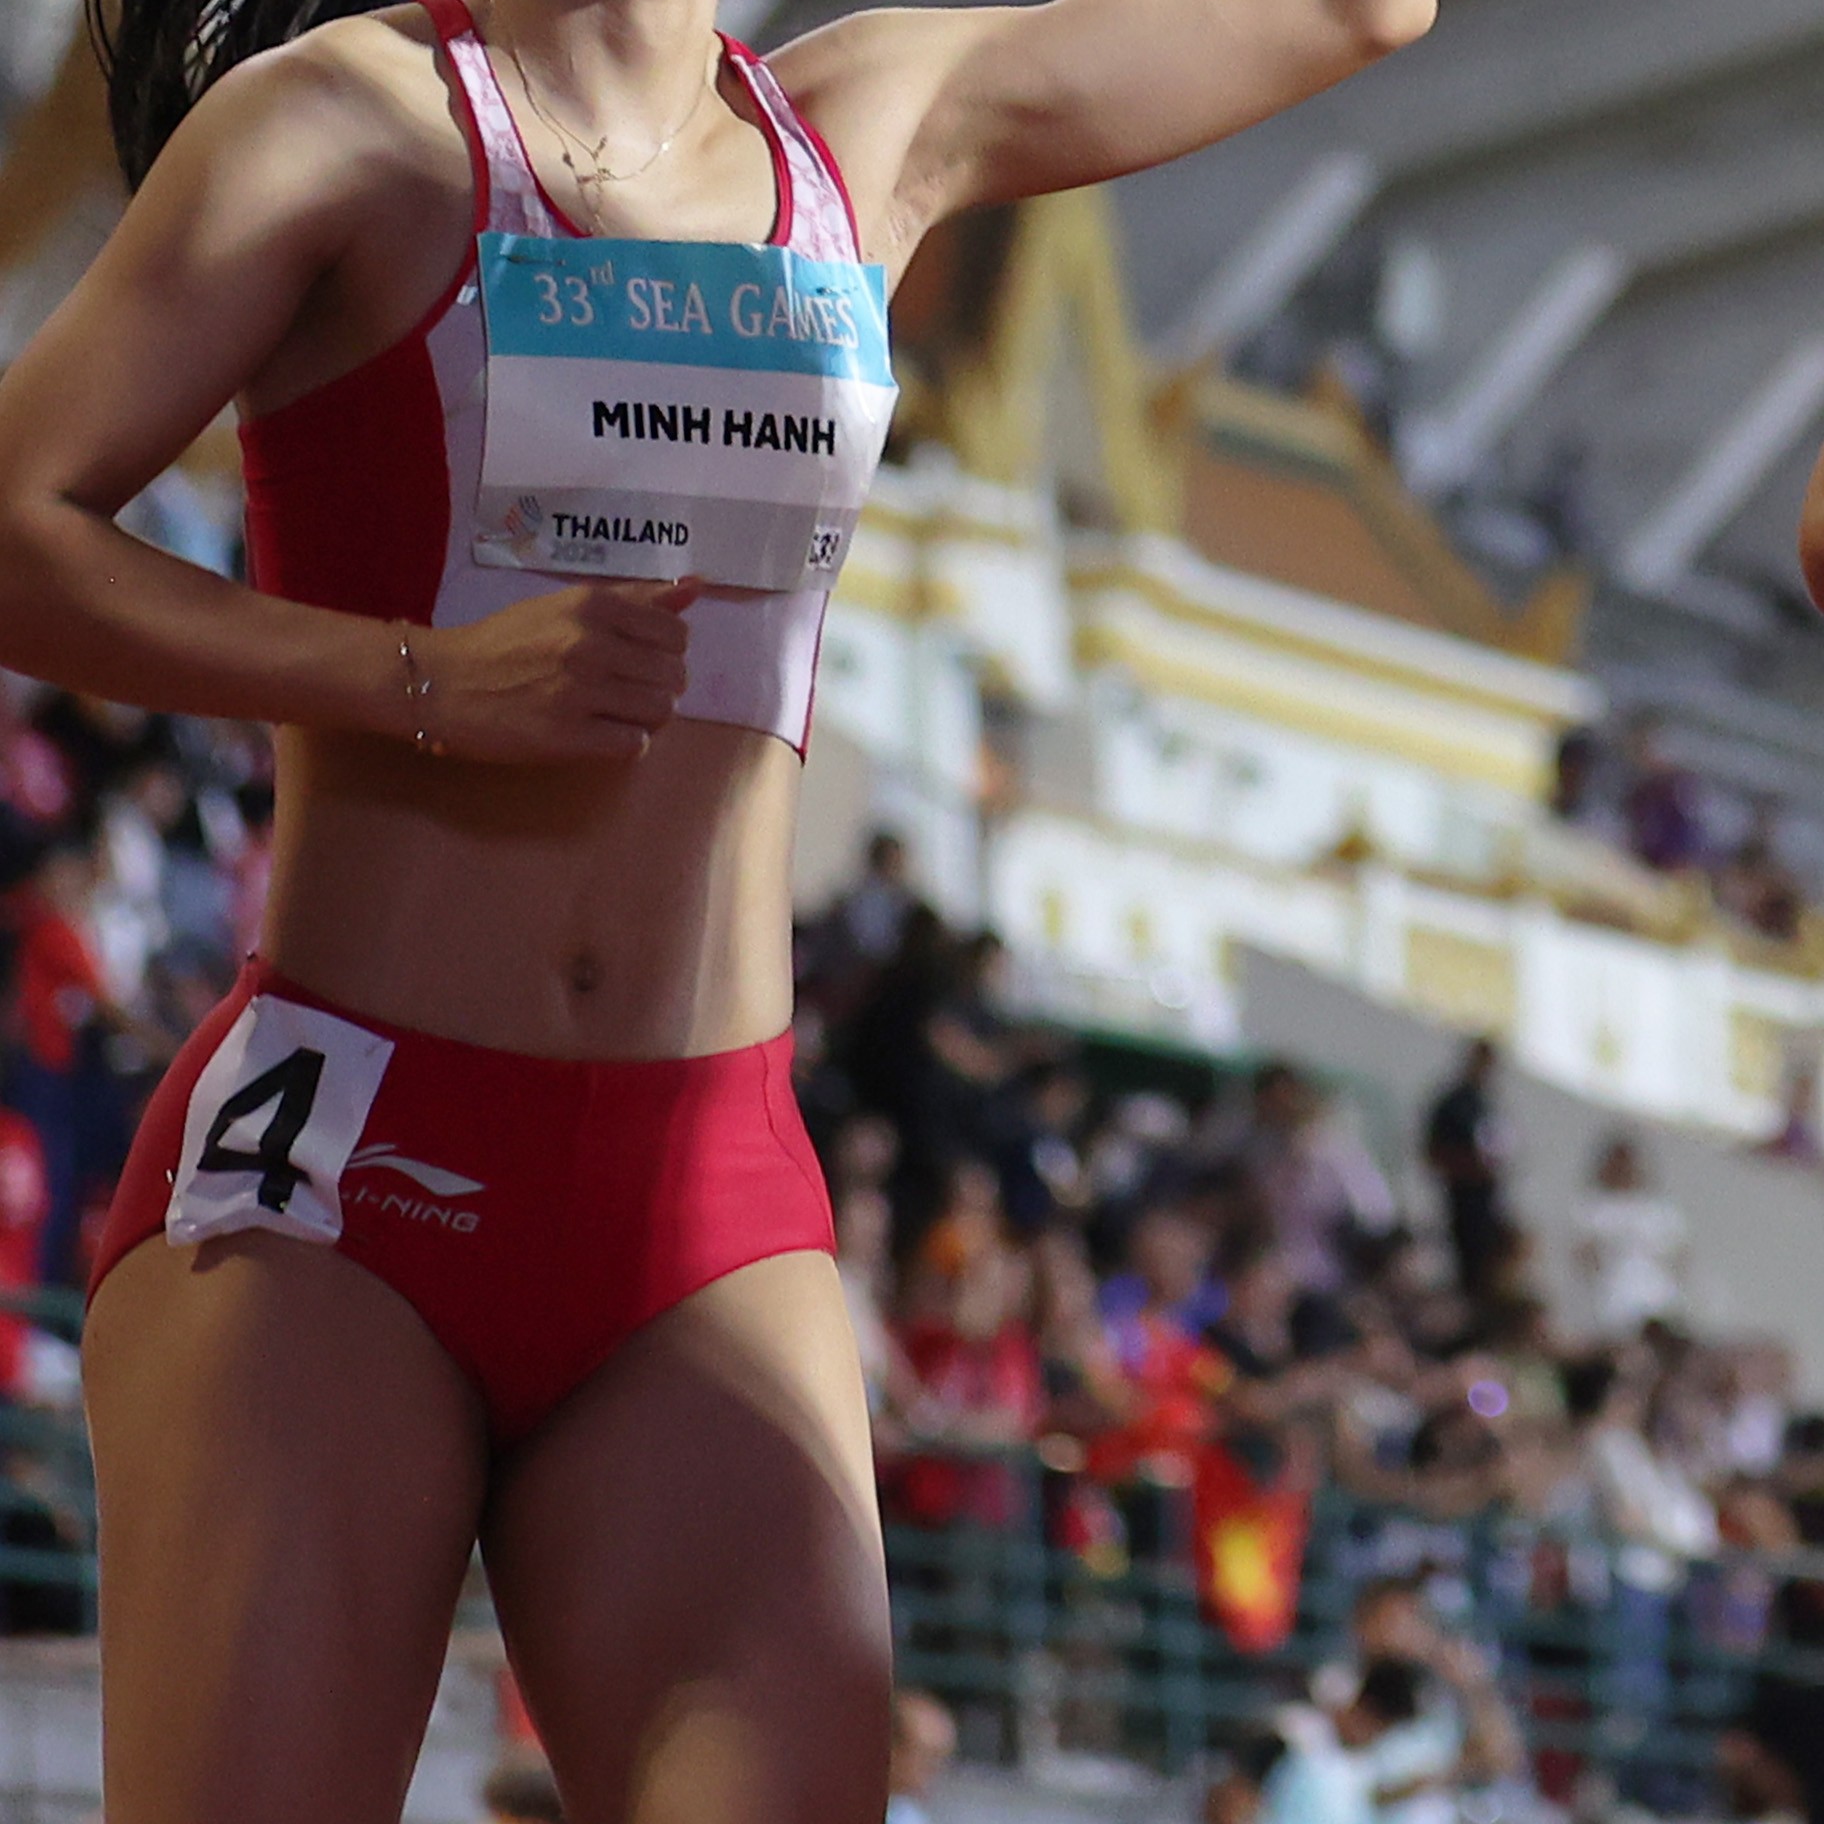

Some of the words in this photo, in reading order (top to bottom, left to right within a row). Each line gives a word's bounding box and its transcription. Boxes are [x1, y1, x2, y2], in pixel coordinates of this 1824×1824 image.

[534, 260, 616, 326] 33rd
[626, 276, 713, 334] SEA
[729, 283, 860, 349] GAMES
[592, 401, 710, 445] MINH
[723, 410, 836, 456] HANH
[552, 513, 690, 547] THAILAND
[197, 1046, 326, 1214] 4
[342, 1176, 480, 1233] I-NING
